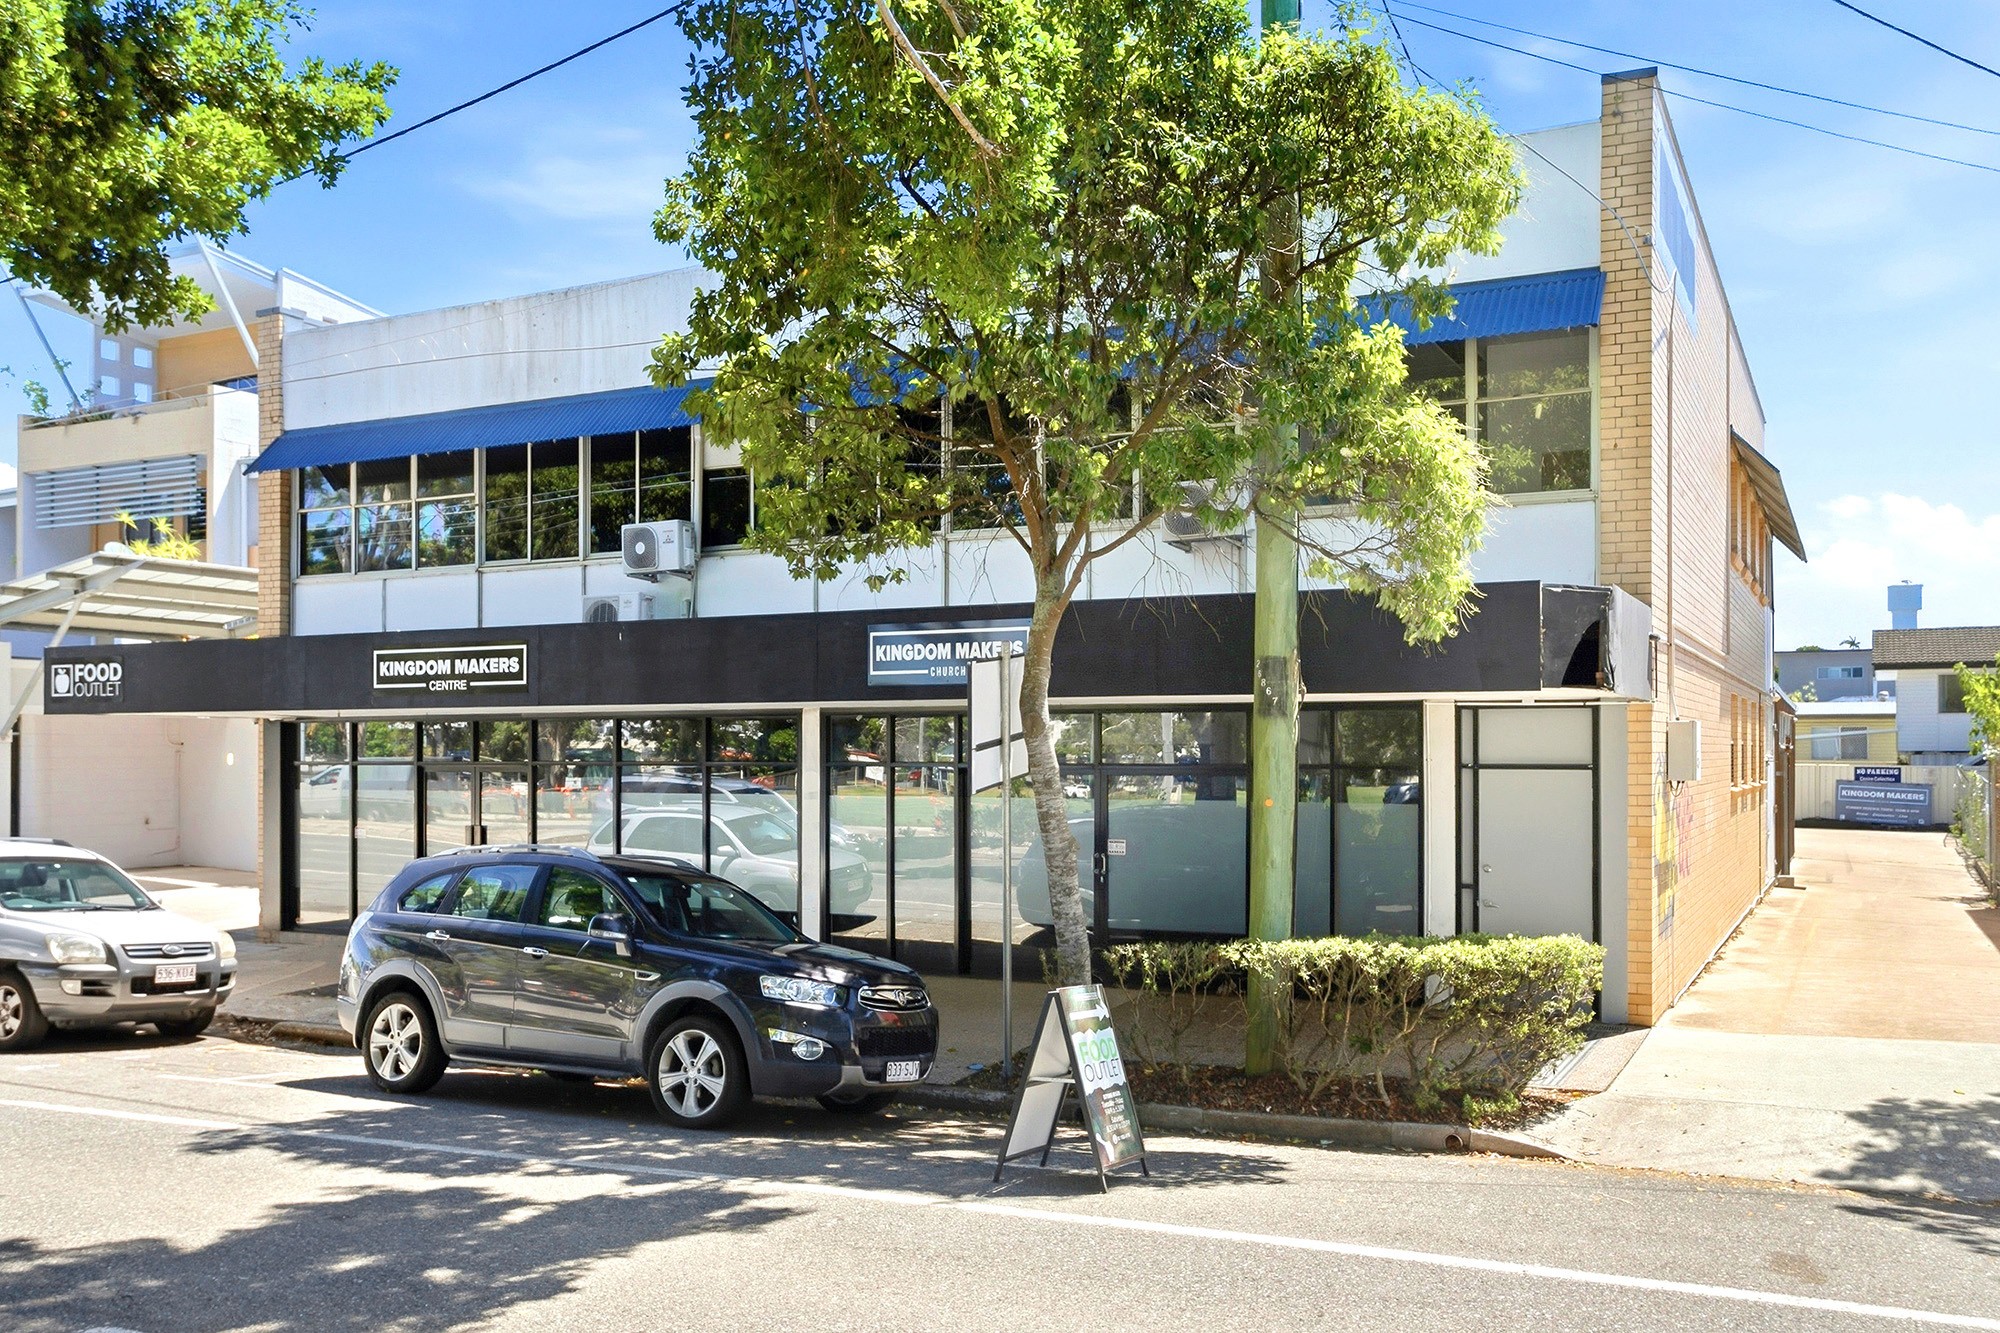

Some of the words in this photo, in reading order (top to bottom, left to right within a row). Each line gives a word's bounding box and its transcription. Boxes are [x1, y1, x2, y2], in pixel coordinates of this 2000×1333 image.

[875, 642, 950, 662] KINGDOM
[74, 662, 122, 682] FOOD
[379, 659, 450, 676] KINGDOM
[454, 657, 520, 675] MAKERS
[930, 665, 966, 677] CHURCH
[74, 681, 121, 697] OUTLET
[428, 680, 467, 691] CENTRE
[1841, 789, 1885, 799] KINGDOM
[1886, 791, 1925, 801] MAKERS
[1079, 1037, 1118, 1064] FOOD
[1084, 1057, 1122, 1082] OUTLET
